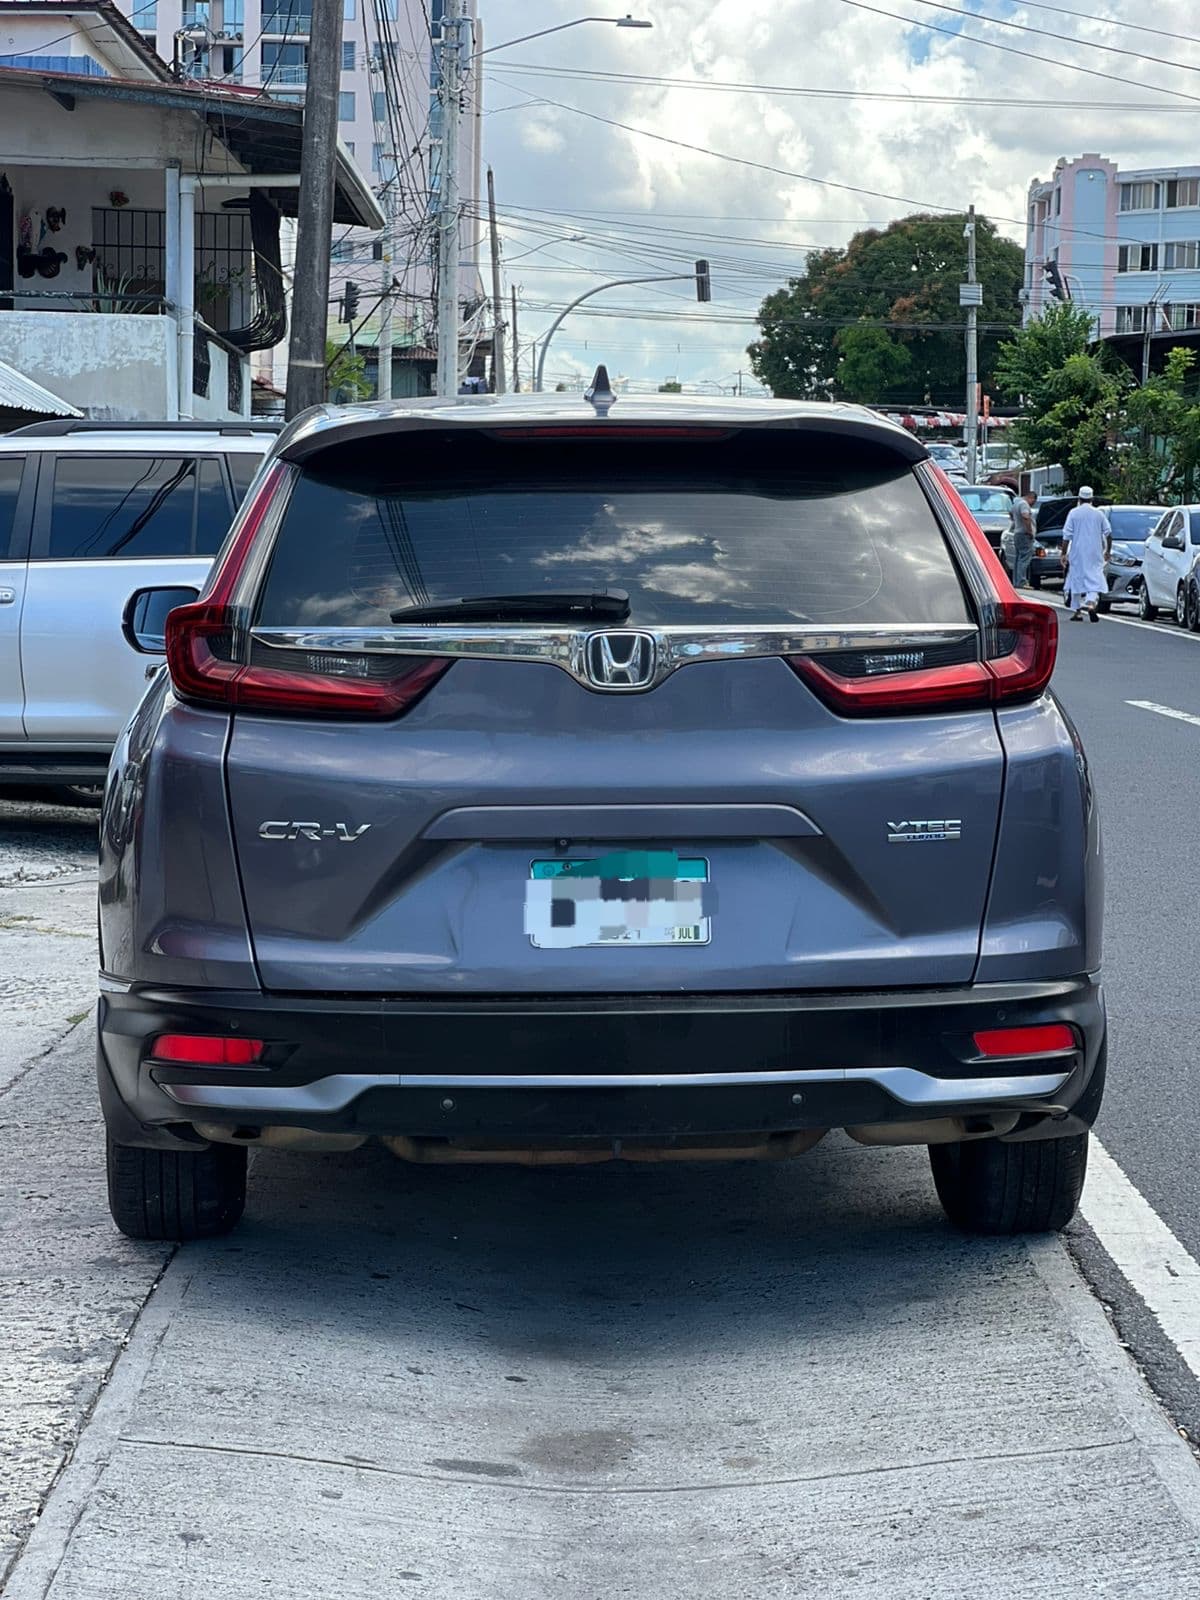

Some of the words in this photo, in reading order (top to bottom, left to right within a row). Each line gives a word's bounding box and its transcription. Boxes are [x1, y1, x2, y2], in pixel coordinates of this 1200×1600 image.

[259, 821, 371, 840] CR-V
[887, 820, 961, 832] VTEC
[678, 927, 692, 939] JUL
